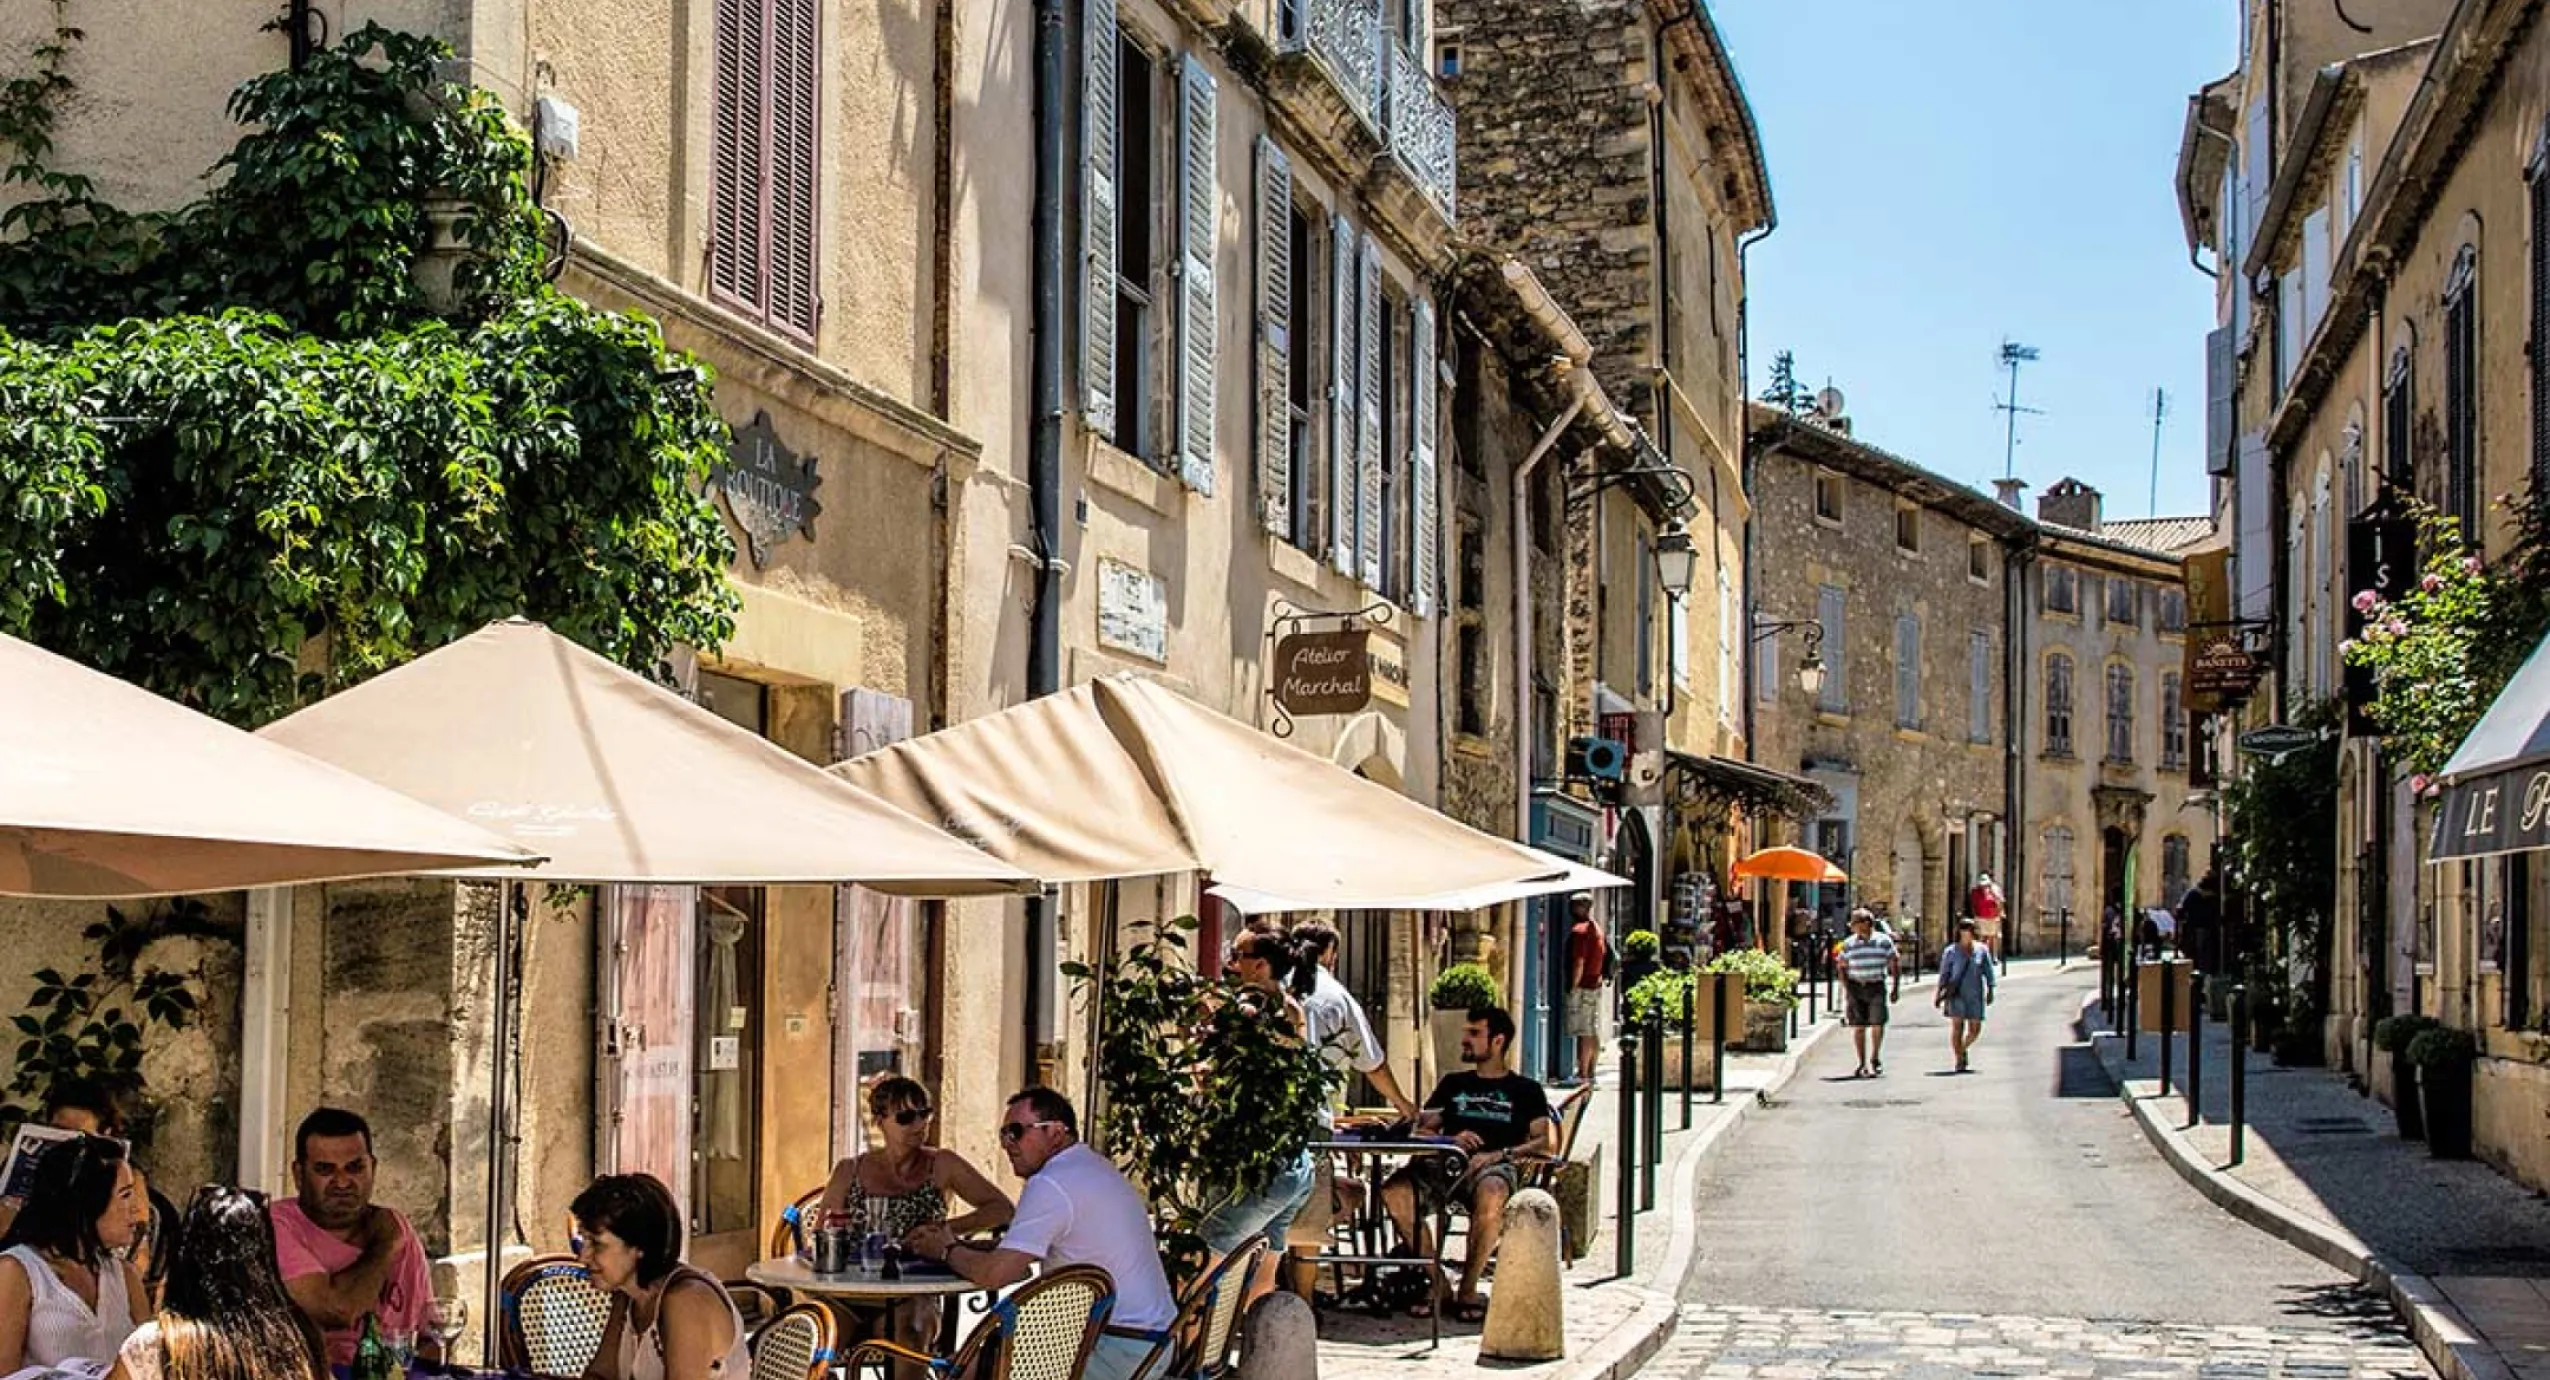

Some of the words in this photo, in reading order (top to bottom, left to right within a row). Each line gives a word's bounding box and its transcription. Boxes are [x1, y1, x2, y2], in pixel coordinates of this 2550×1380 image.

[755, 438, 776, 475] LA
[1282, 674, 1361, 703] Marchal
[2464, 785, 2500, 836] LE
